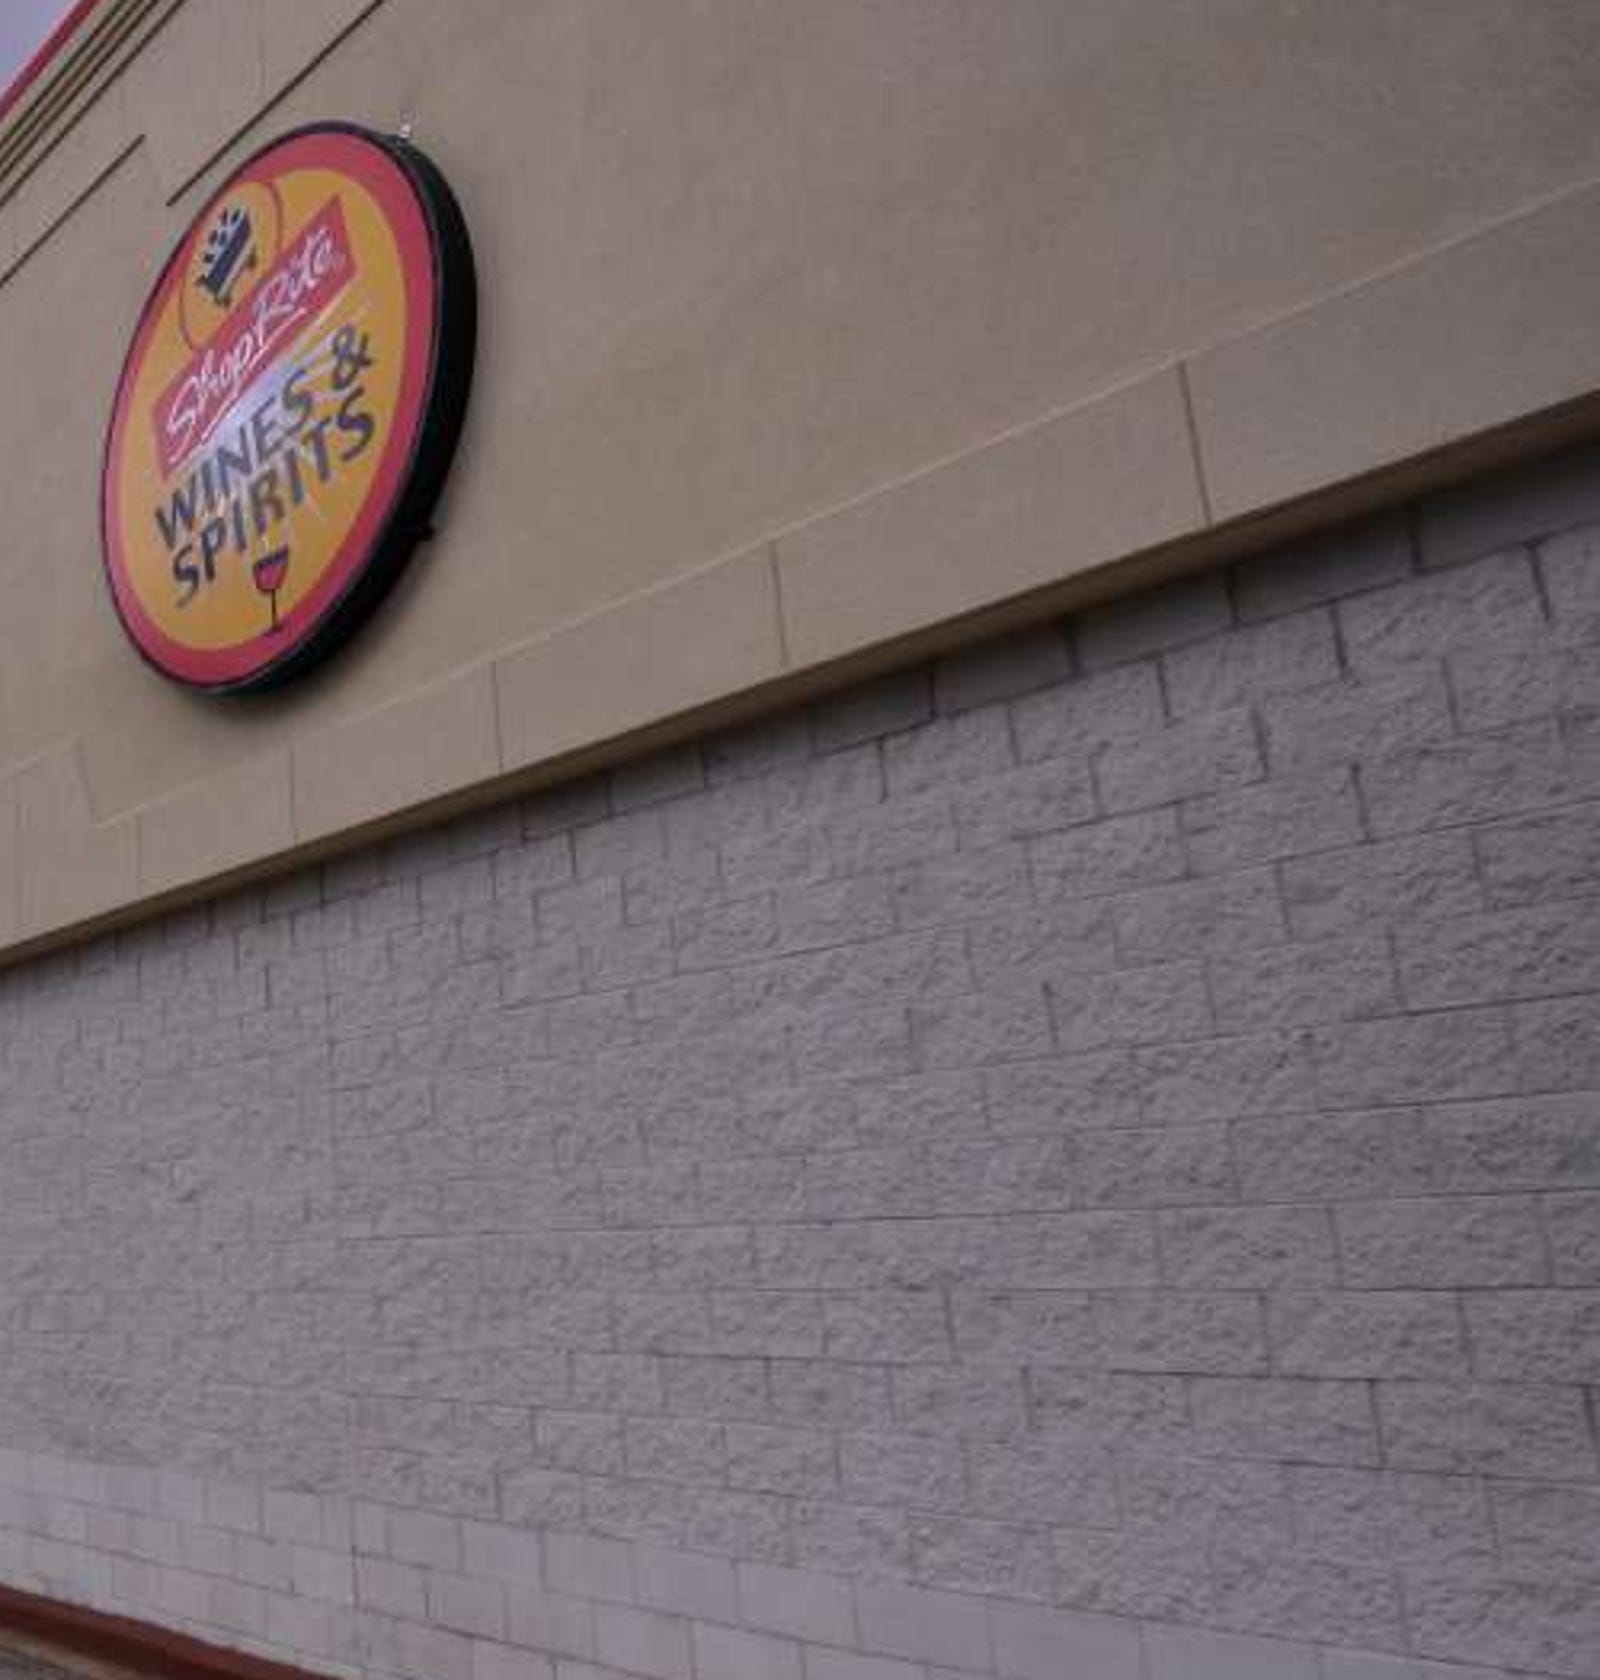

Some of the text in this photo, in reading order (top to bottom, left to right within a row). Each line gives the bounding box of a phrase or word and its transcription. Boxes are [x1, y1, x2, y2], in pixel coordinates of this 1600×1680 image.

[155, 326, 373, 548] WINES &
[172, 387, 374, 608] SPIRITS
